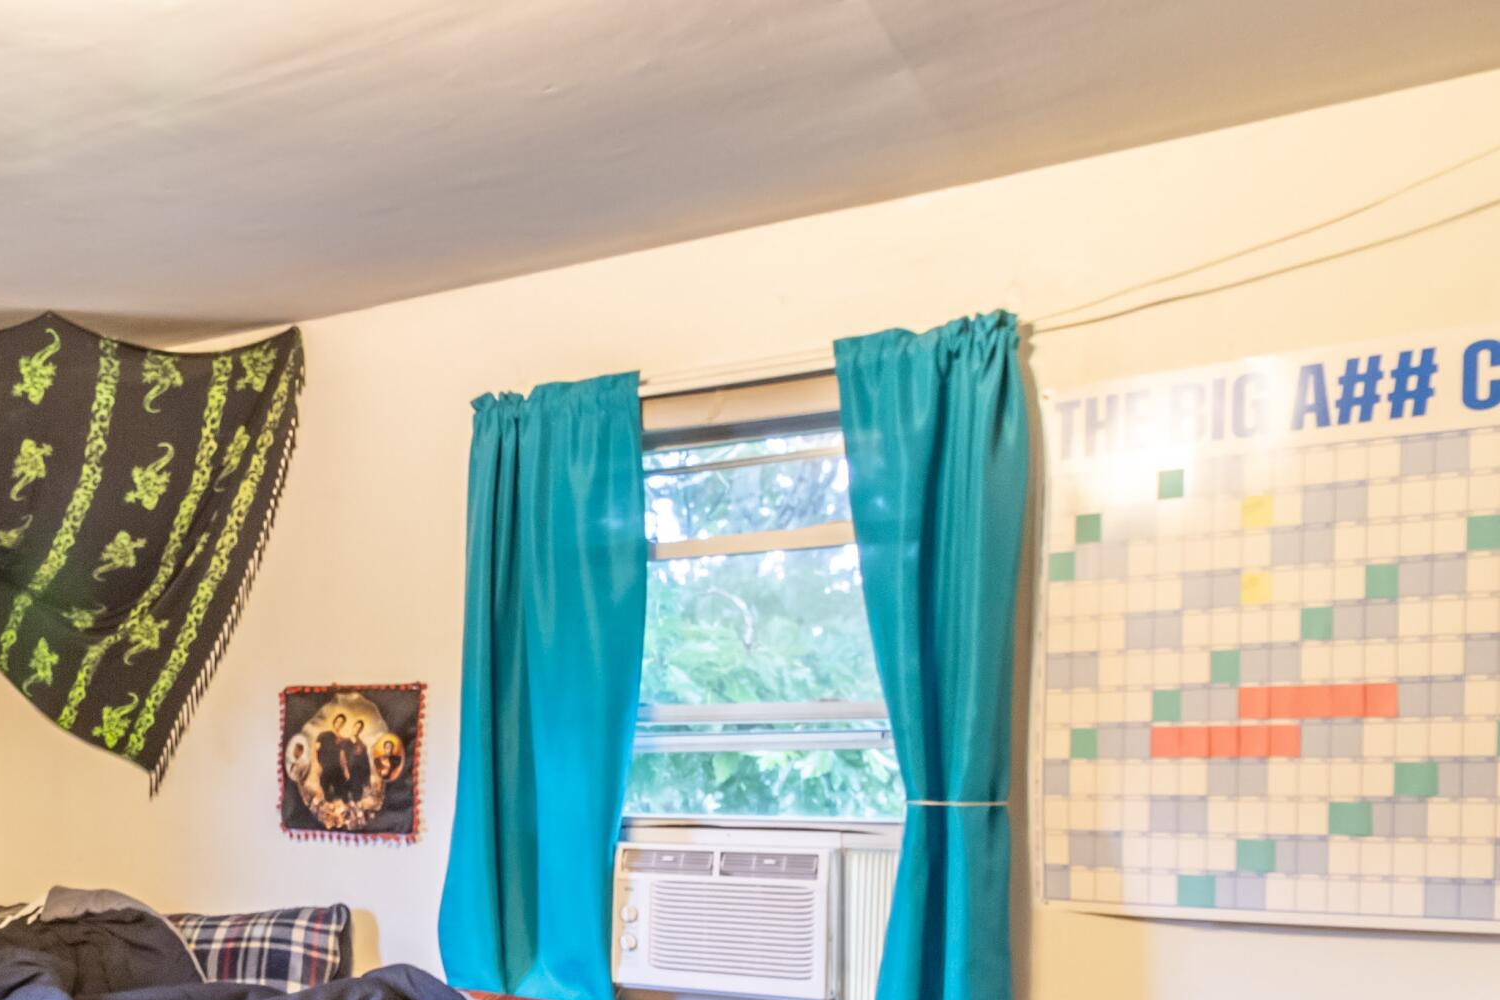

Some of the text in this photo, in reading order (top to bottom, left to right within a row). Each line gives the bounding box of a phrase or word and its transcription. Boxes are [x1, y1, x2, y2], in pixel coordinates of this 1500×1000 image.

[1054, 389, 1150, 461] THE
[1170, 372, 1268, 444] BIG
[1290, 347, 1439, 431] A##
